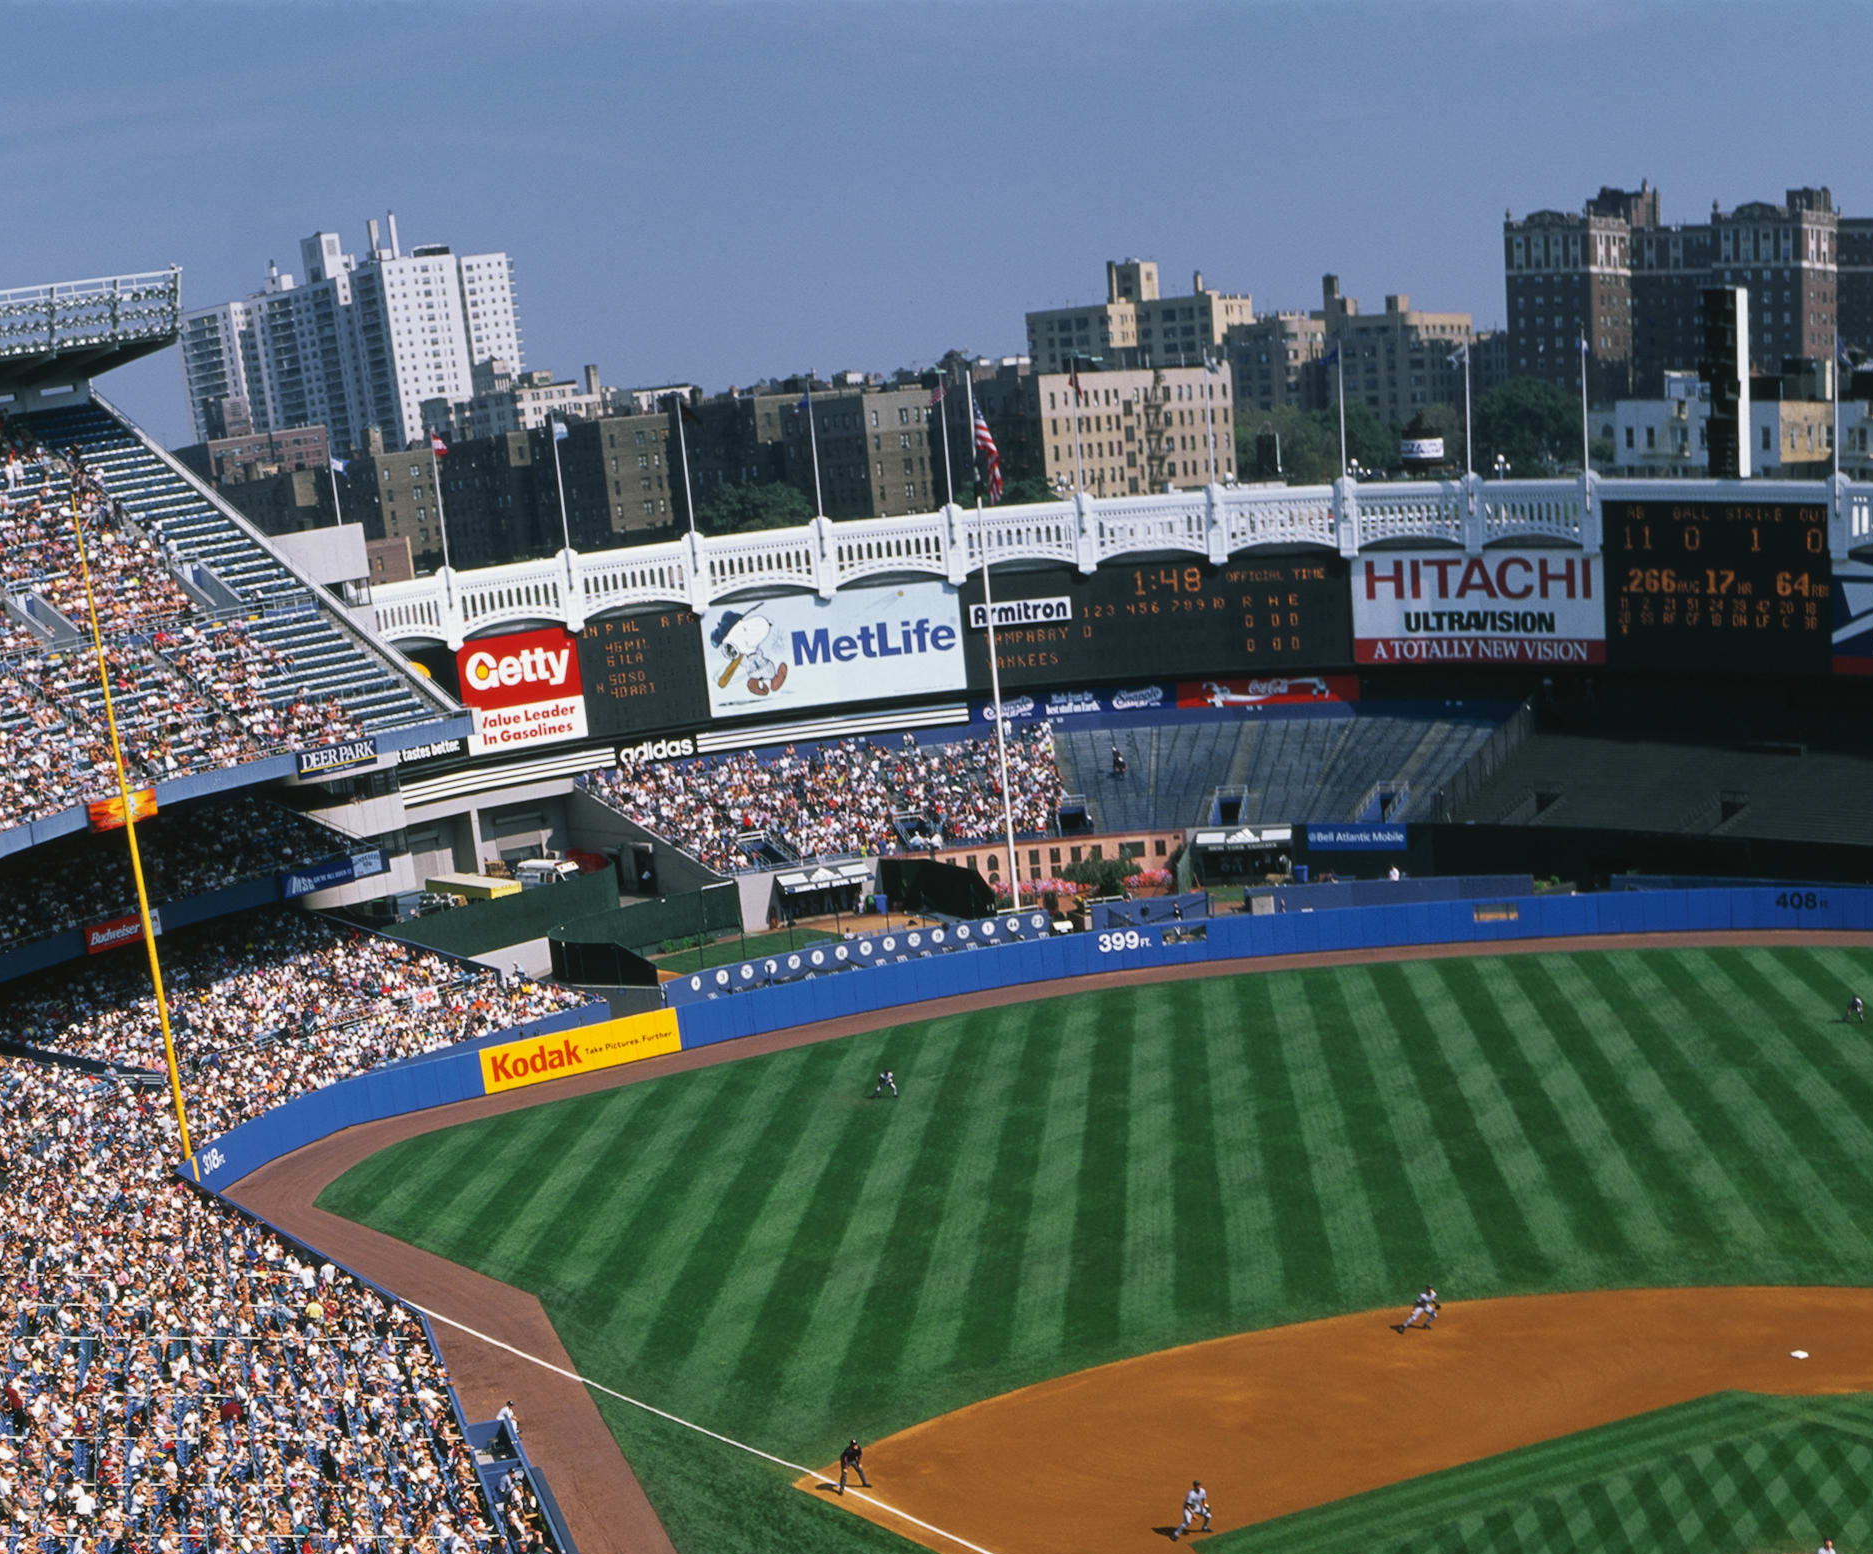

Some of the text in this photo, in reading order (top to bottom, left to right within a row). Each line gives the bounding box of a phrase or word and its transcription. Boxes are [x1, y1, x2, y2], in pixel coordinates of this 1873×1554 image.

[1725, 507, 1783, 523] STRIKE
[1684, 525, 1701, 551] 0
[1750, 527, 1761, 553] 1
[1806, 527, 1823, 553] 0
[1135, 567, 1325, 596] 1:48 OFFICIAL TIME
[1364, 557, 1592, 601] HITACHI
[1623, 568, 1677, 594] .266
[1705, 569, 1736, 596] 17
[1776, 570, 1810, 598] 64
[974, 602, 1068, 625] Armitron
[1404, 610, 1556, 634] ULTRAVISION
[790, 618, 957, 667] MetLife
[1374, 640, 1588, 662] A TOTALLY NEW VISION
[465, 646, 570, 691] Getty
[523, 704, 576, 723] Leader
[483, 722, 574, 746] In Gasolines
[301, 747, 338, 770] DEER
[338, 740, 375, 762] PARK
[402, 746, 431, 762] tastes
[619, 737, 694, 765] adidas
[1316, 830, 1405, 844] Bell Atlantic Mobile
[90, 922, 141, 947] Budweiser
[1097, 930, 1153, 953] 399 FT.
[491, 1039, 583, 1083] Kodak
[585, 1046, 604, 1056] Take
